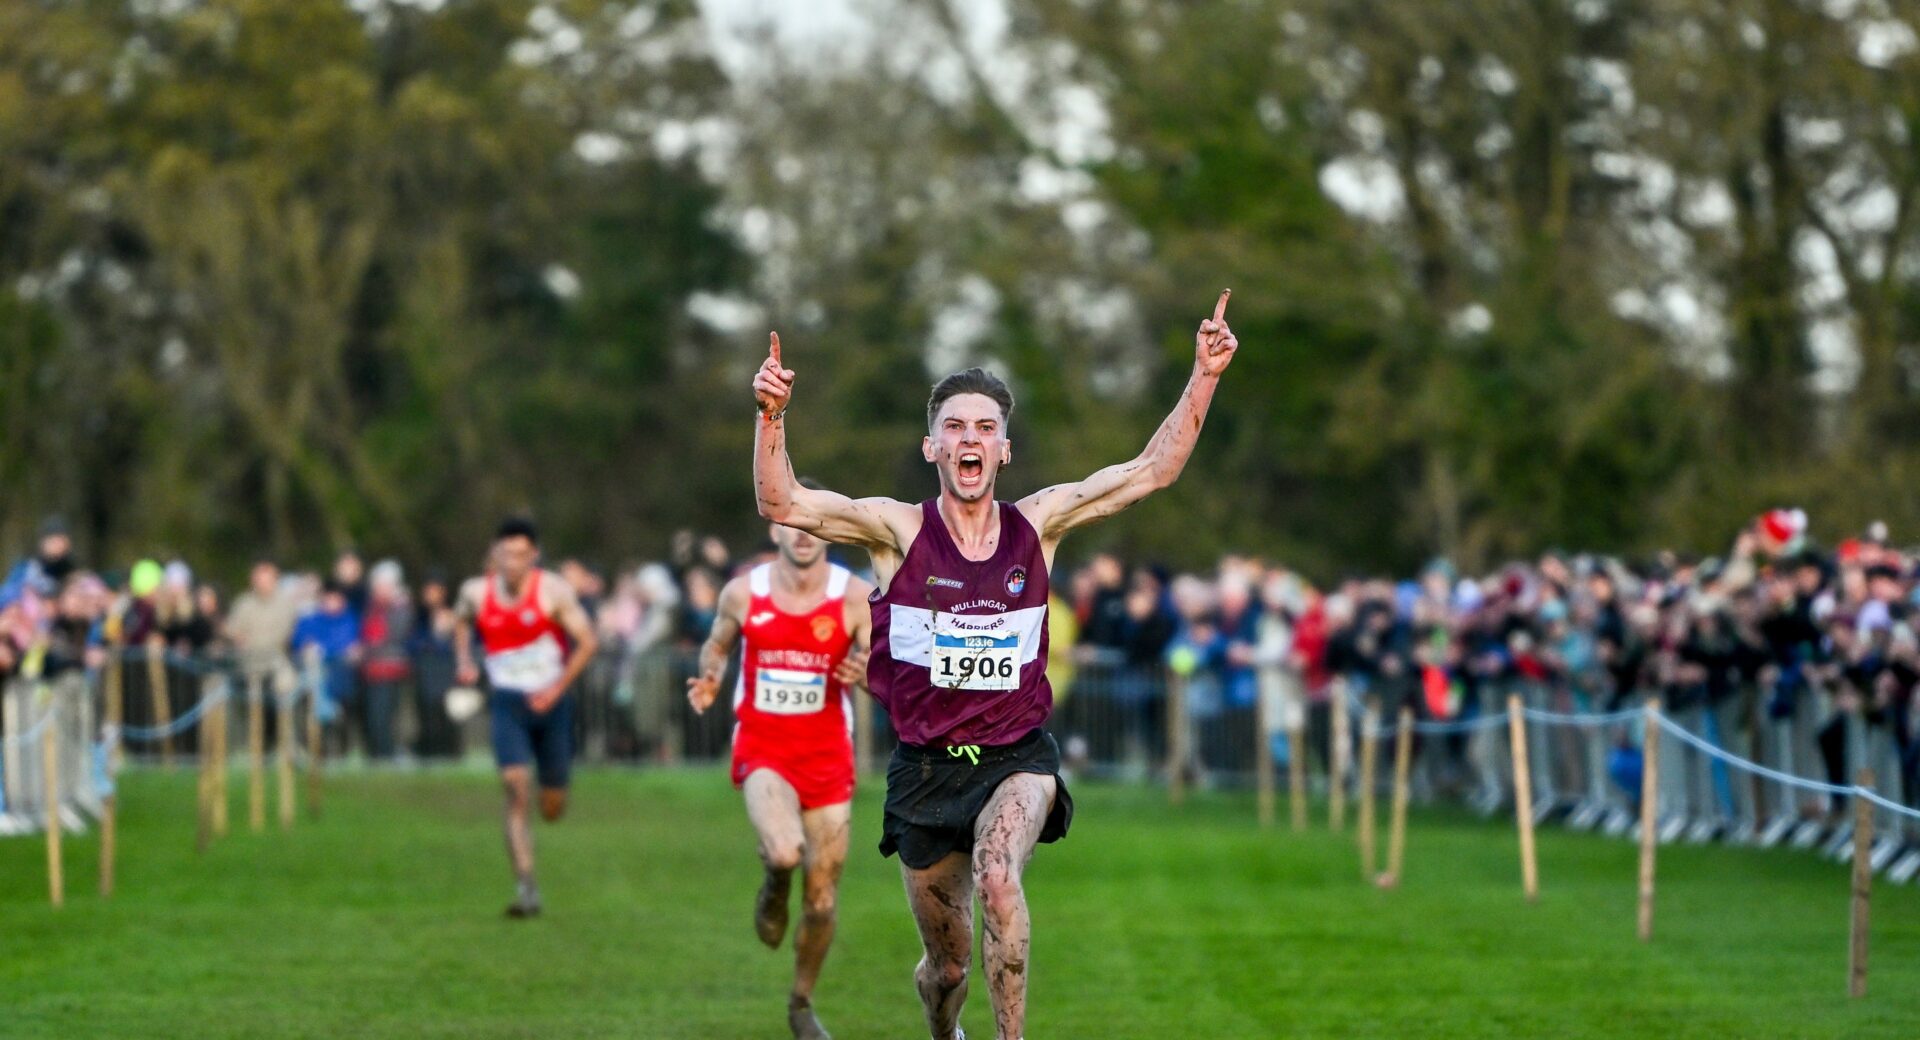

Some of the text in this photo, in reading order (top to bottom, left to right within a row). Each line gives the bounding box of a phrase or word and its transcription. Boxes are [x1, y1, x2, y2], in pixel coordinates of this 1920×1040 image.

[950, 599, 1007, 614] MULLINGAR
[964, 636, 994, 647] 123.ie
[940, 656, 1013, 678] 1906
[763, 688, 818, 705] 1930
